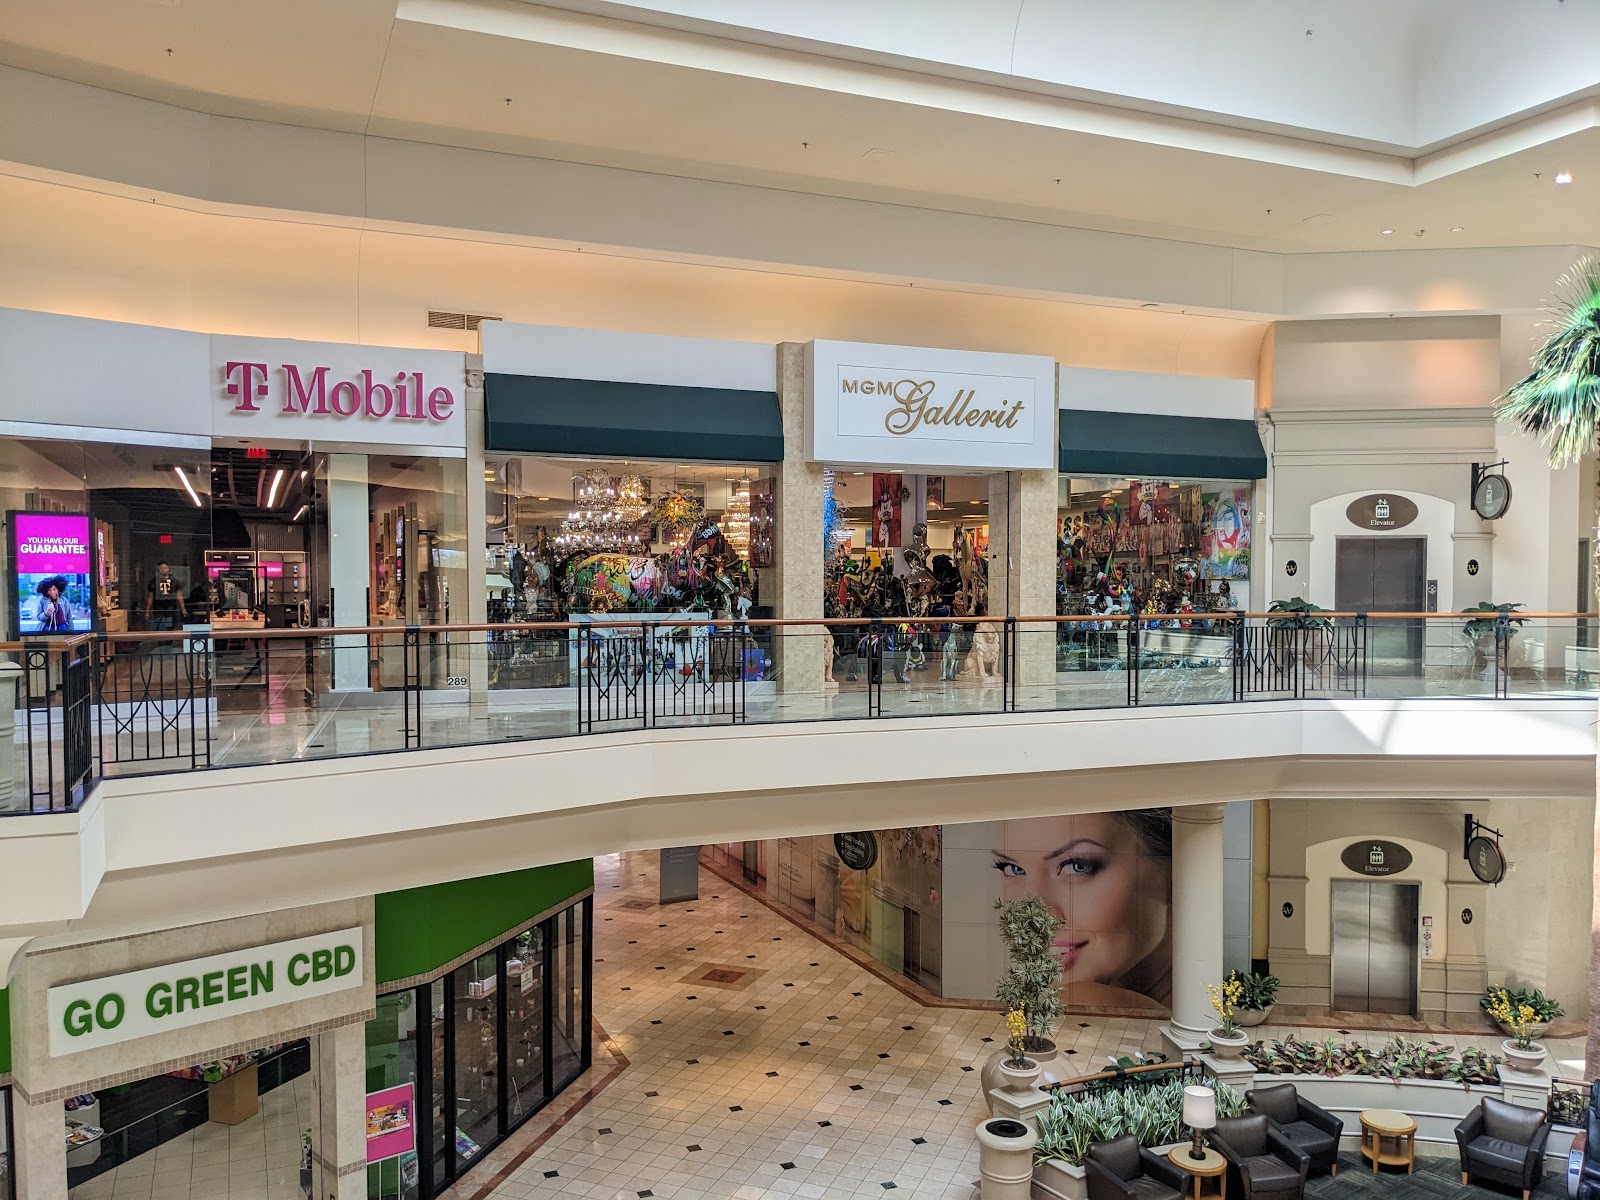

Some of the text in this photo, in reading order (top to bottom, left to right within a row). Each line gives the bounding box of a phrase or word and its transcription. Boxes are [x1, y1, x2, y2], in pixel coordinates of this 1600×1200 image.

[281, 364, 455, 421] Mobile
[842, 379, 1025, 435] MGM Gallerit
[20, 544, 86, 554] GUARANTEE
[27, 536, 43, 544] YOU
[63, 537, 79, 545] OUR
[448, 677, 467, 686] 289
[63, 945, 356, 1037] GO GREEN CBD
